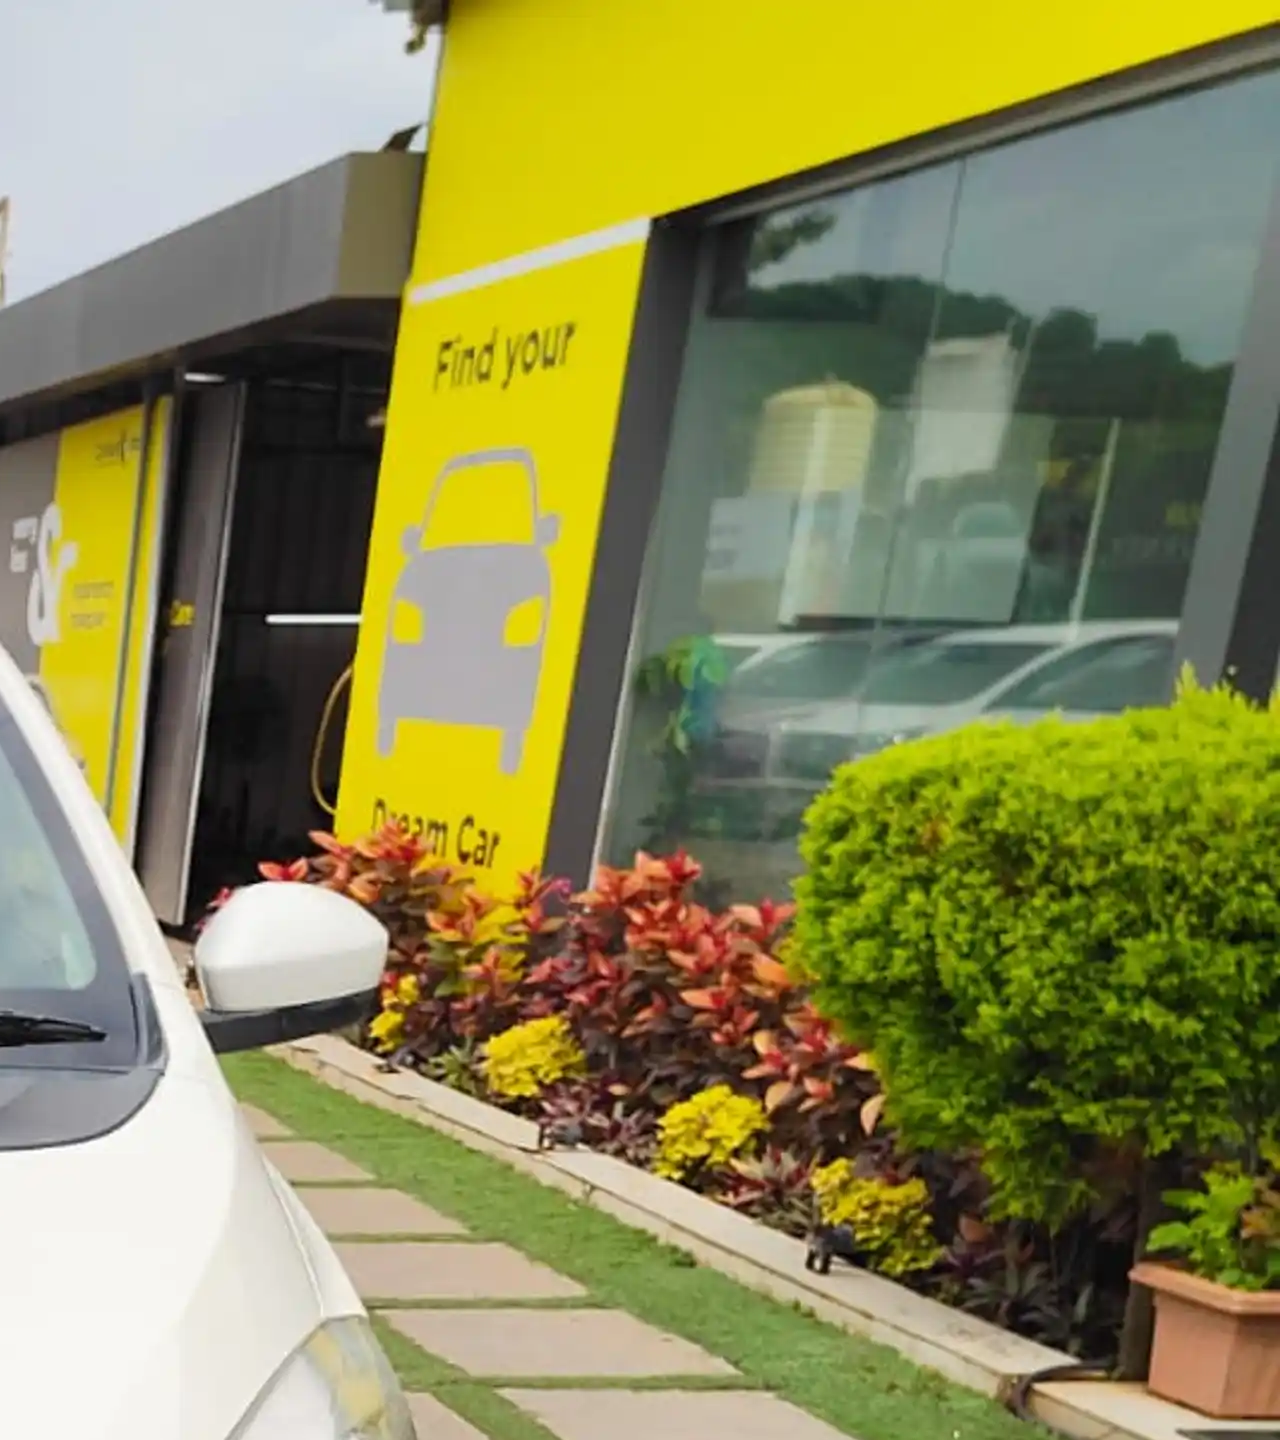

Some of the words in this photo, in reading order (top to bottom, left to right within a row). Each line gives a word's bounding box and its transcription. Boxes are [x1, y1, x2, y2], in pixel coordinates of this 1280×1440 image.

[433, 327, 498, 393] Find
[501, 322, 575, 389] your
[457, 815, 500, 868] Car
